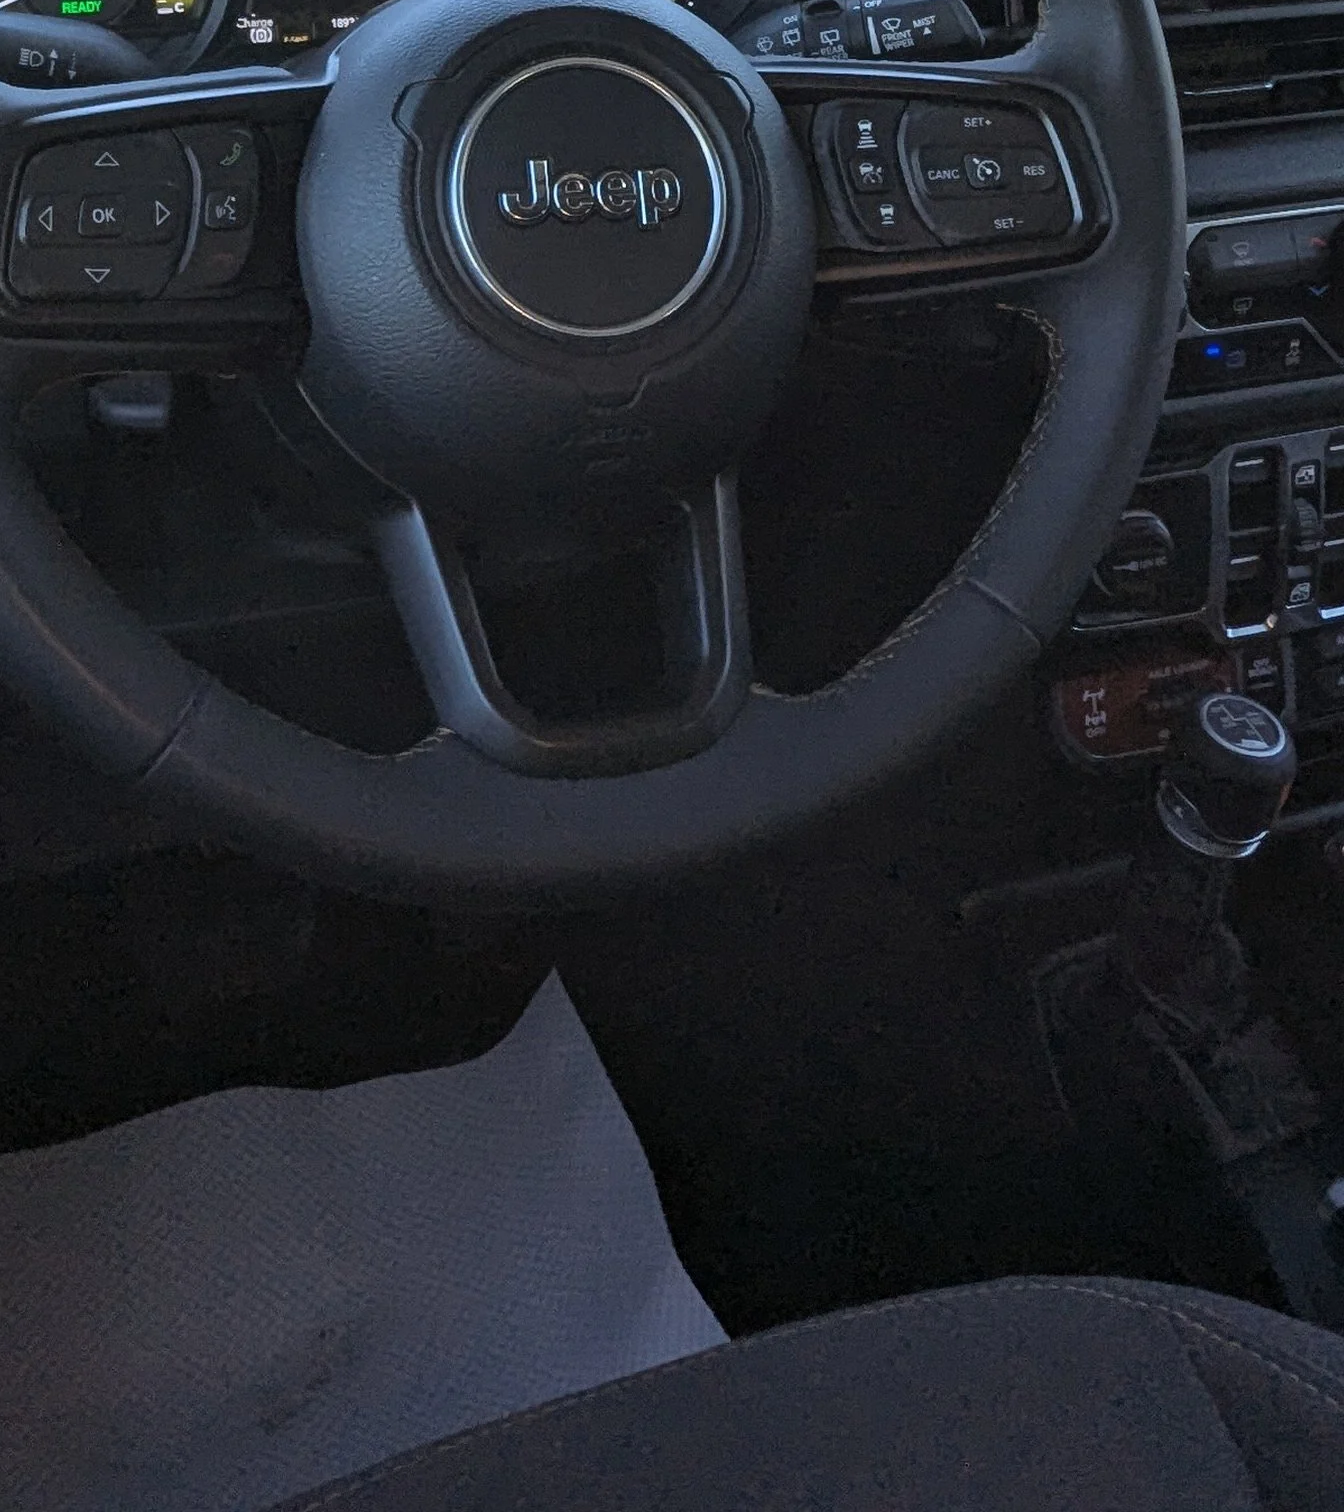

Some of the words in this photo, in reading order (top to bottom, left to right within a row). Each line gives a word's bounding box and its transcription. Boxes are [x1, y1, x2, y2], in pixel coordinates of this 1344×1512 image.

[61, 0, 103, 16] READY
[174, 1, 185, 13] C
[235, 17, 274, 32] Charge
[913, 15, 936, 29] MIST
[881, 29, 913, 42] FRONT
[883, 38, 915, 52] WIPER
[927, 168, 961, 181] CANC
[1022, 165, 1046, 176] RES
[498, 158, 684, 231] Jeep
[91, 207, 117, 224] OK
